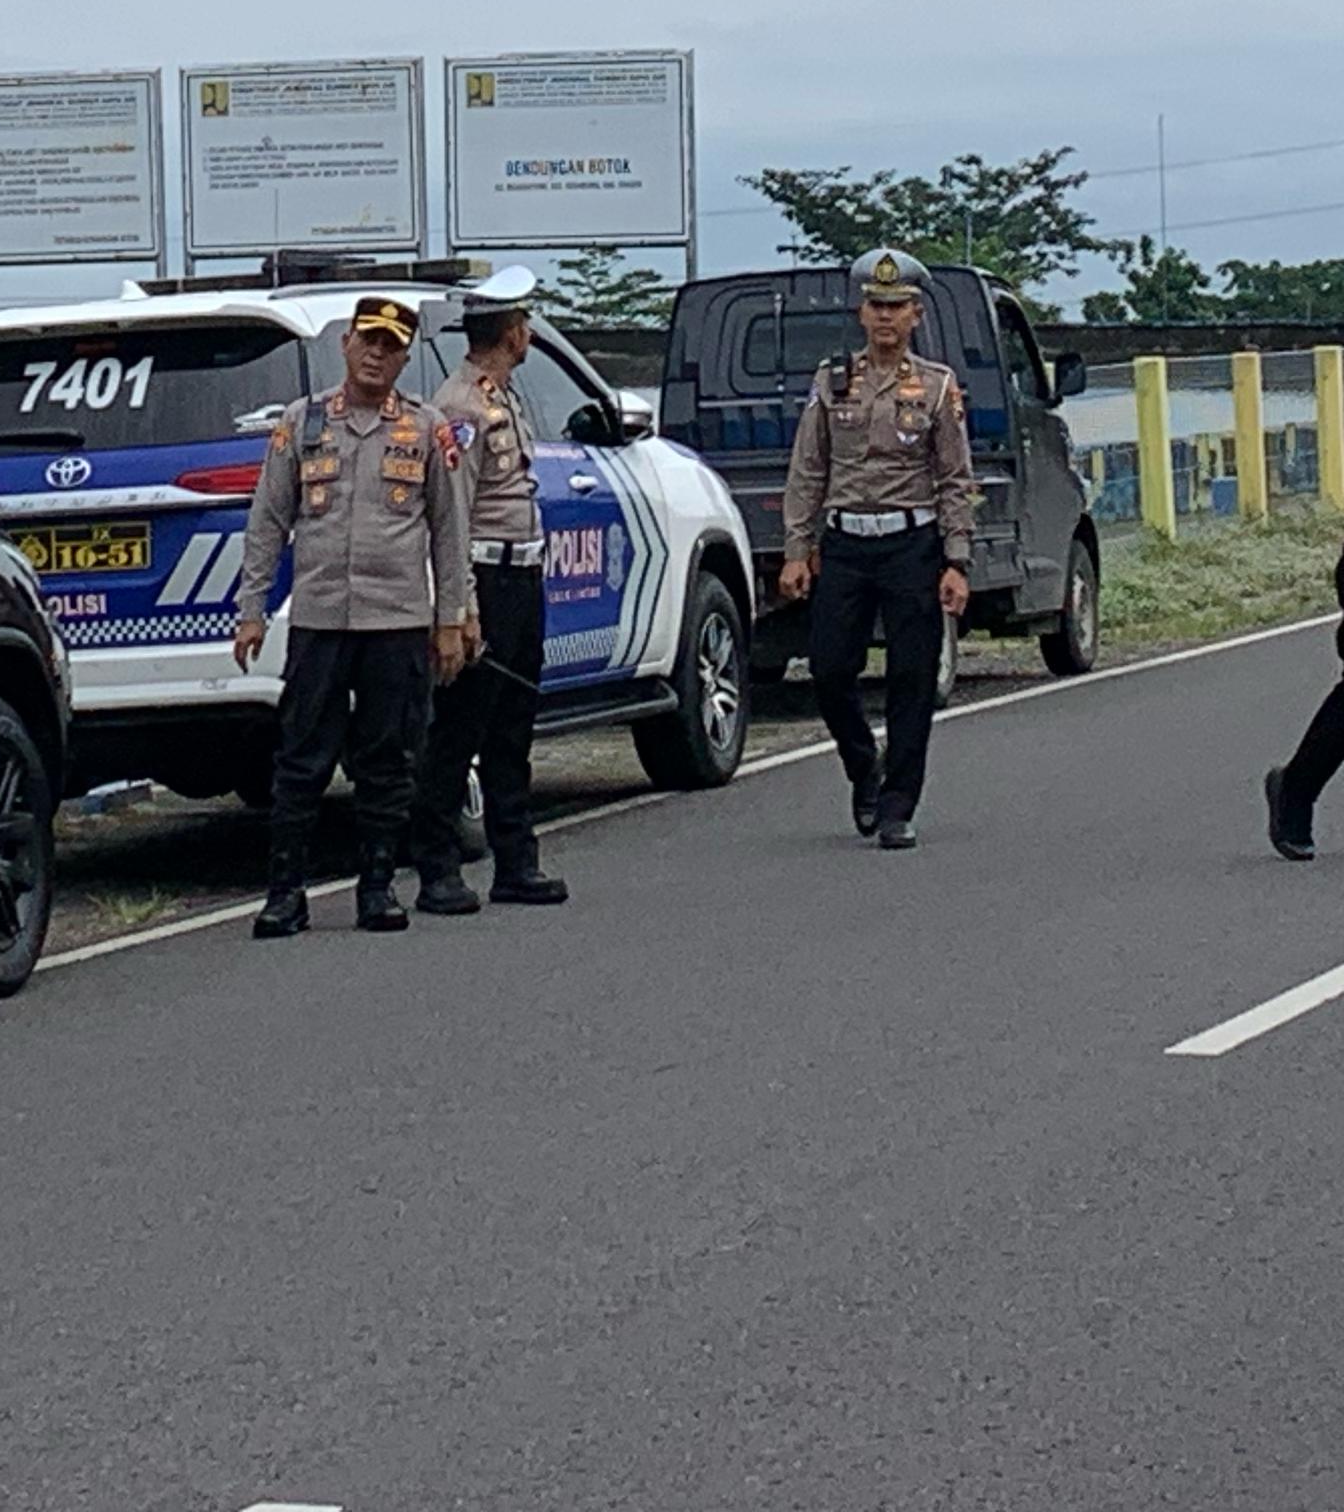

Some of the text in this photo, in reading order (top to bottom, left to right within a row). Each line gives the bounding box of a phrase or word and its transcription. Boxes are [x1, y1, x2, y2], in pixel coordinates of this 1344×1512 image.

[505, 157, 632, 177] BENDUNGAN BOTOK
[19, 355, 154, 413] 7401
[91, 525, 112, 542] IX
[549, 529, 603, 579] POLISI
[47, 594, 106, 617] OLISI
